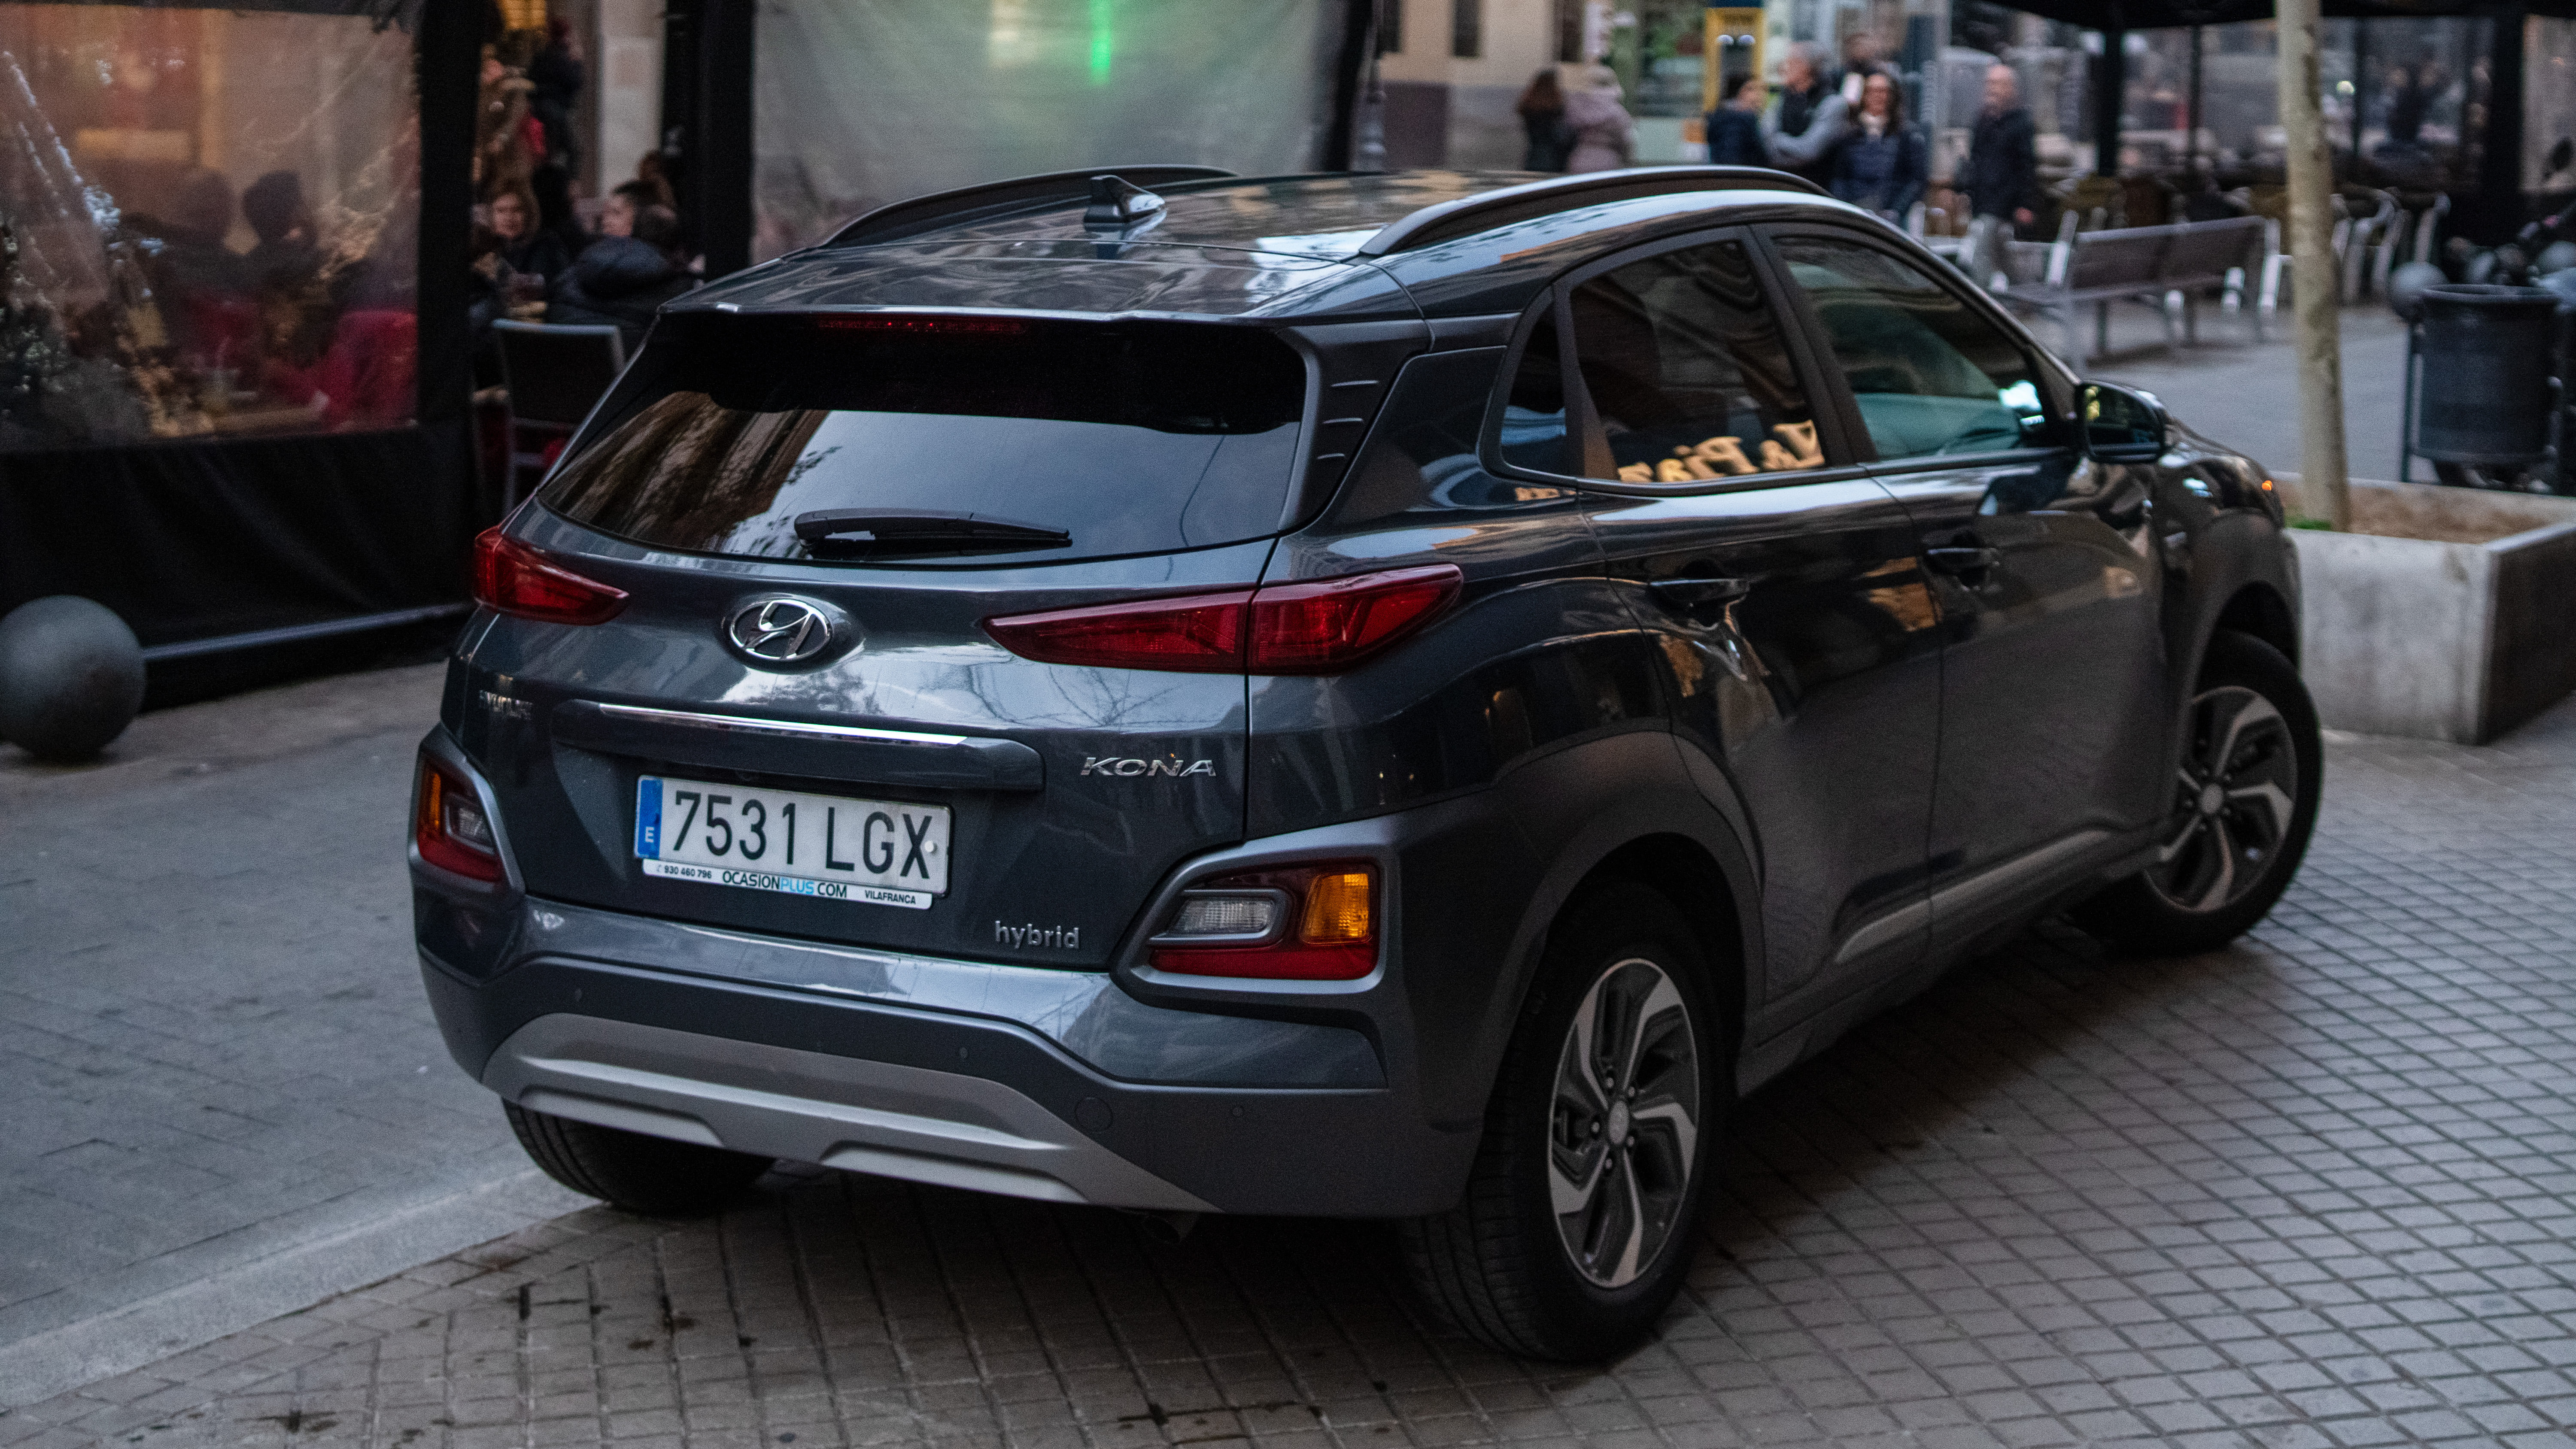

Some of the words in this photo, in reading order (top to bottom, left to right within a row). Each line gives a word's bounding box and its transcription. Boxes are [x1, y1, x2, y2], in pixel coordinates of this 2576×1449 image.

[1081, 757, 1216, 776] KONA
[645, 826, 654, 843] E
[673, 790, 796, 864] 7531
[826, 806, 933, 879] LGX
[665, 865, 678, 874] 930
[865, 889, 916, 904] VILAFRANCA
[995, 921, 1079, 949] hybrid
